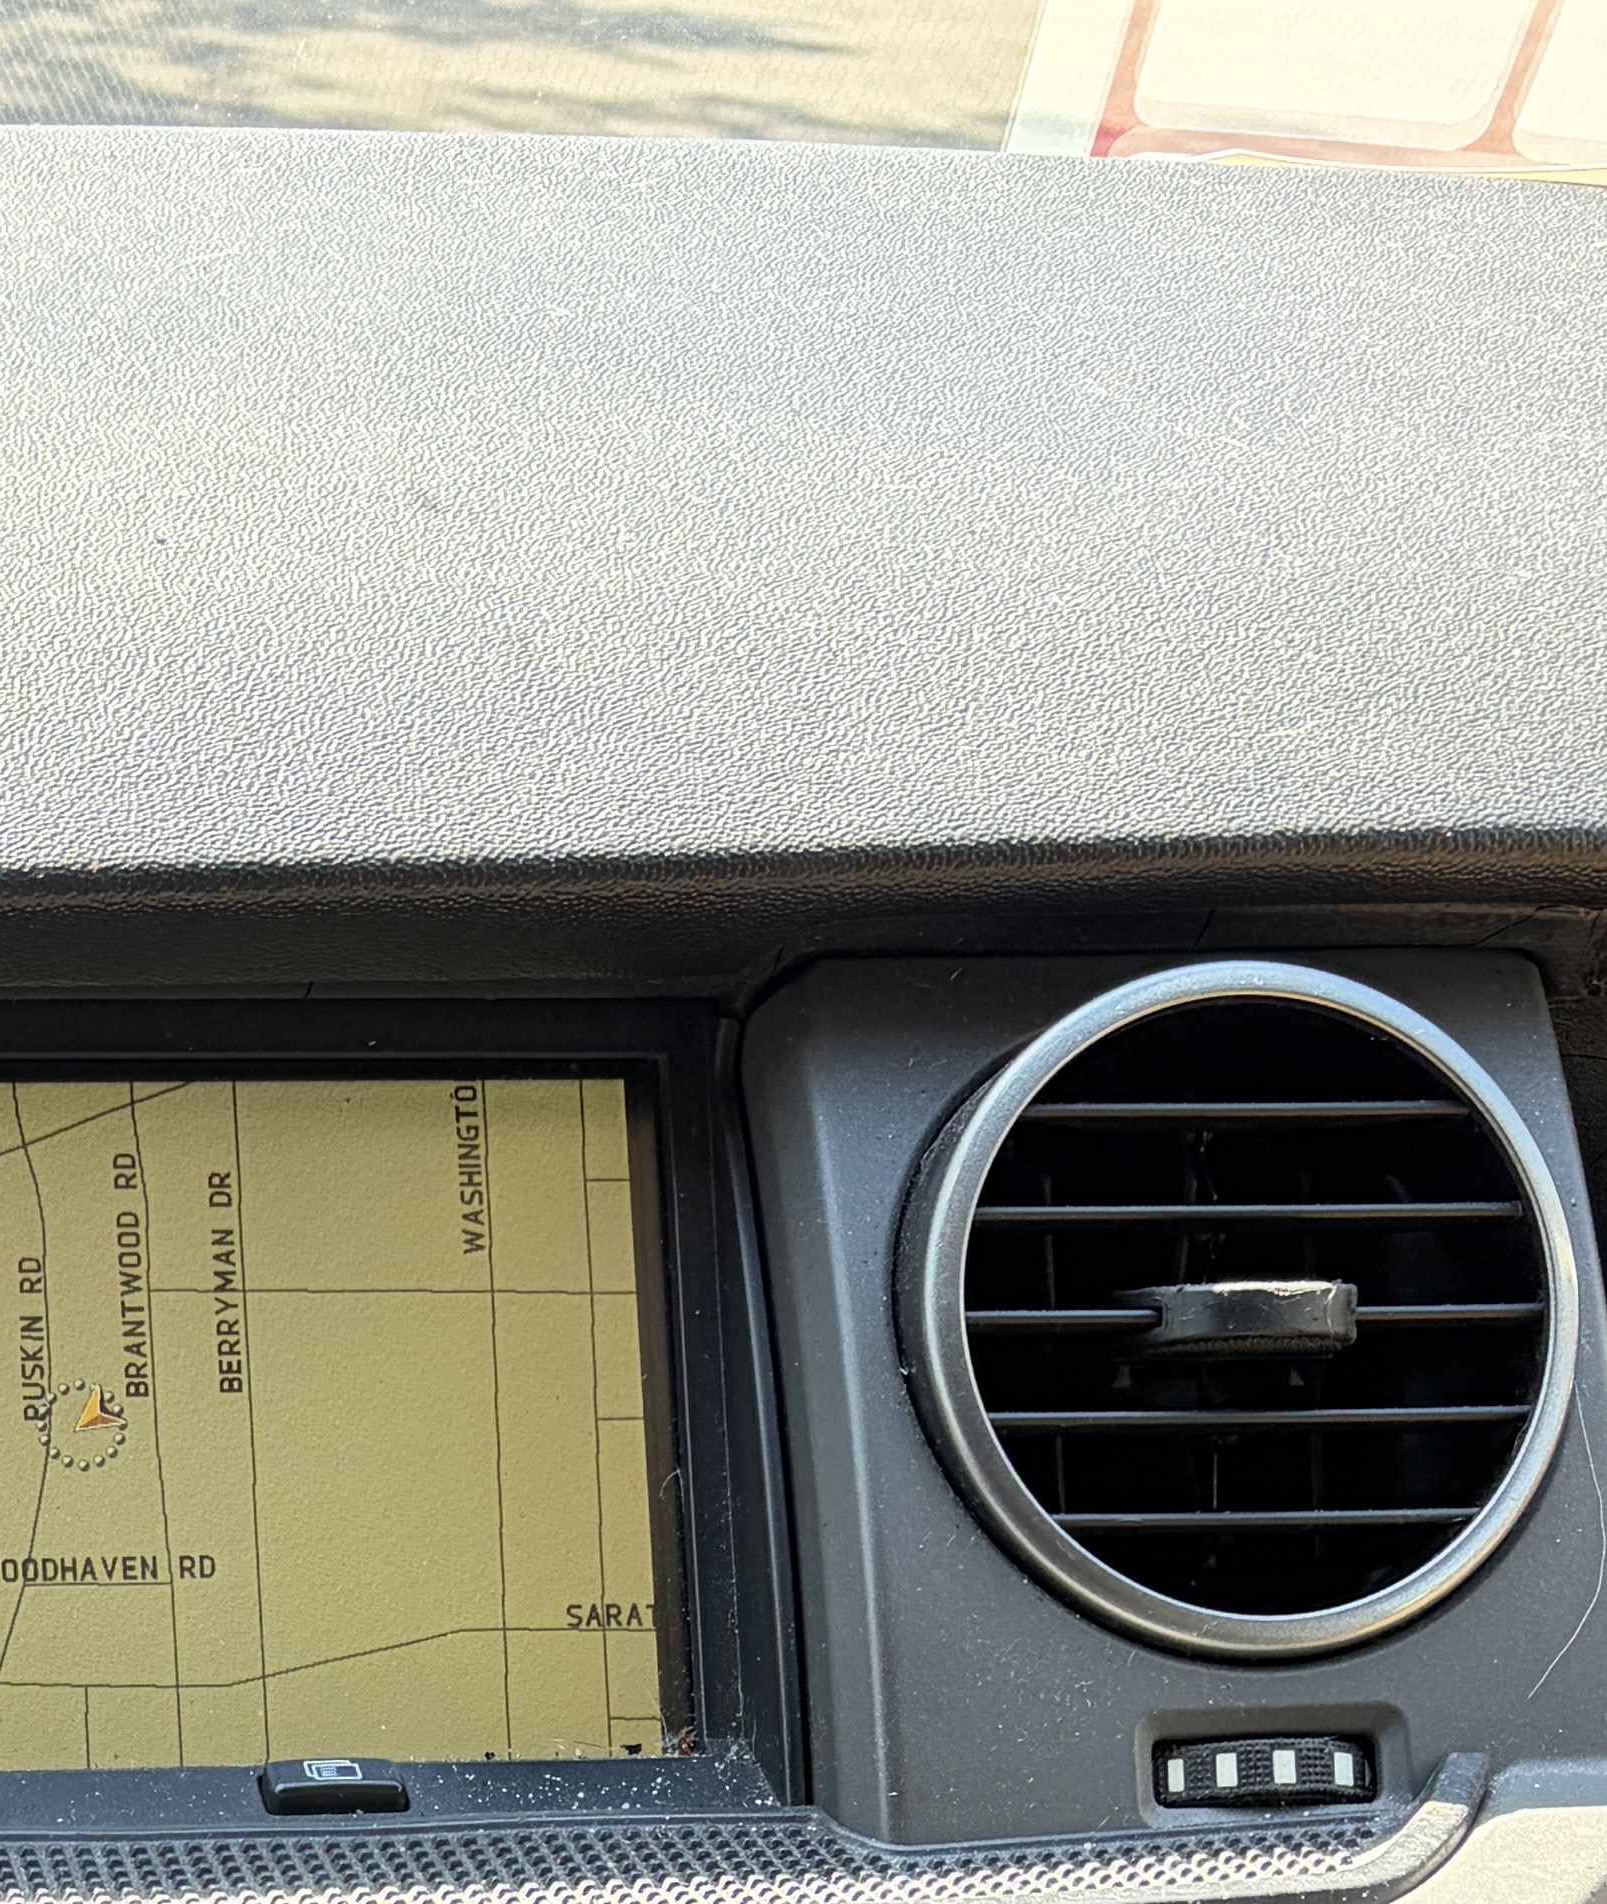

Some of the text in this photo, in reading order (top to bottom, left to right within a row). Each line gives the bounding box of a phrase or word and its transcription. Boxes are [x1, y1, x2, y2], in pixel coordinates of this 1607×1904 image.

[18, 1257, 46, 1421] RUSKIN RD
[113, 1153, 149, 1397] BRANTWOOD RD
[208, 1171, 243, 1393] BERRYMAN DR
[179, 1555, 216, 1580] RD
